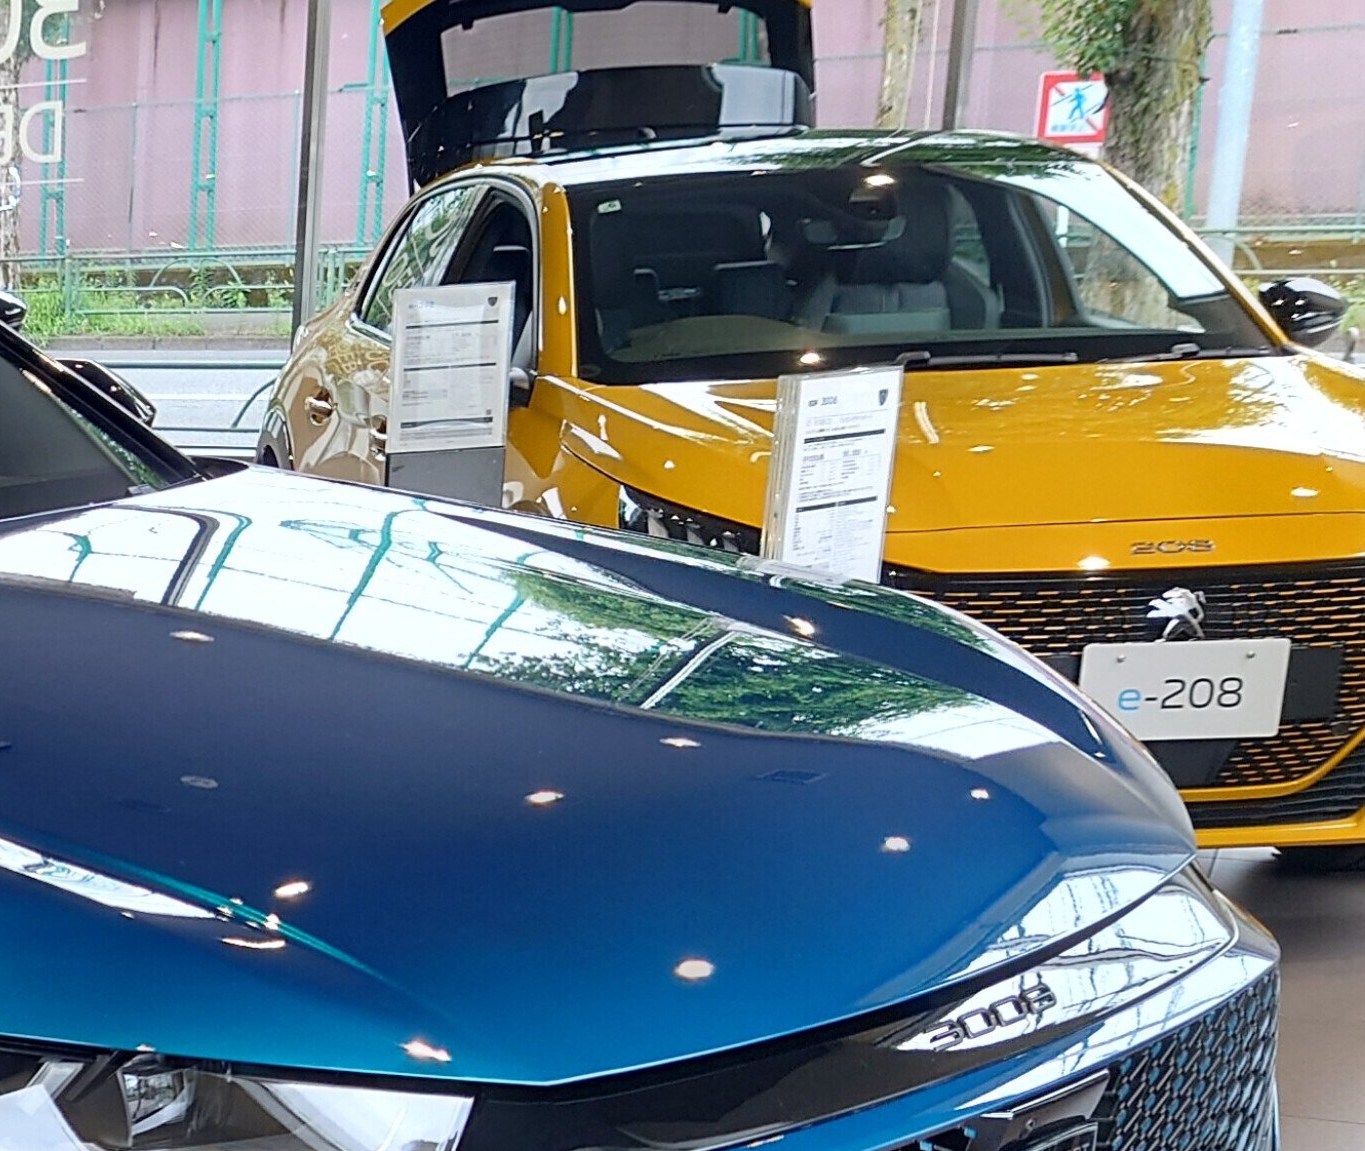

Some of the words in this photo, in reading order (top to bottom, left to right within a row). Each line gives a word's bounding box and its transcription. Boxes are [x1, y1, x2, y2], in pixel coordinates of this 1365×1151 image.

[1130, 539, 1215, 555] 208
[1117, 677, 1244, 711] e-208
[923, 983, 1058, 1053] 3008
